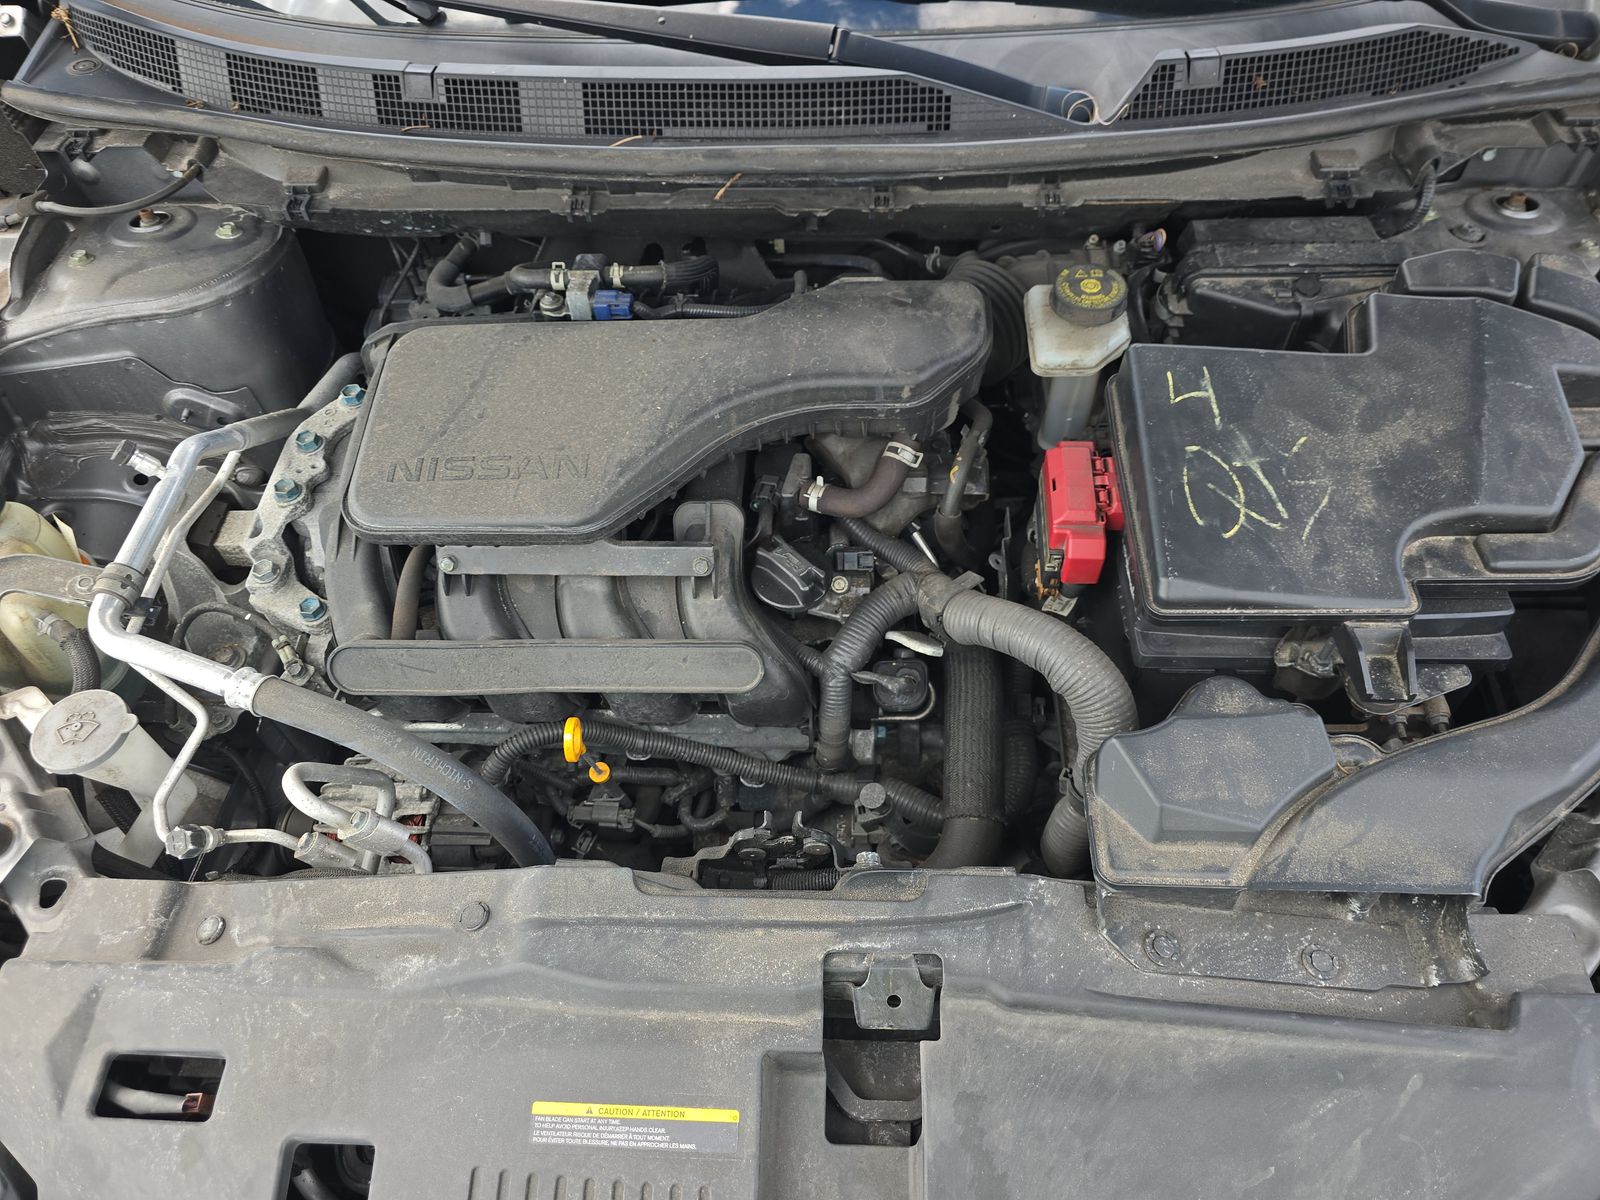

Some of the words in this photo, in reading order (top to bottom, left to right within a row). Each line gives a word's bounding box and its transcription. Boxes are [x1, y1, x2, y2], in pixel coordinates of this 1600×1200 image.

[1166, 365, 1223, 432] 4
[386, 453, 590, 483] NISSAN
[598, 1107, 634, 1116] CAUTION
[642, 1109, 686, 1118] ATTENTION
[600, 1132, 628, 1140] DÉMARRER
